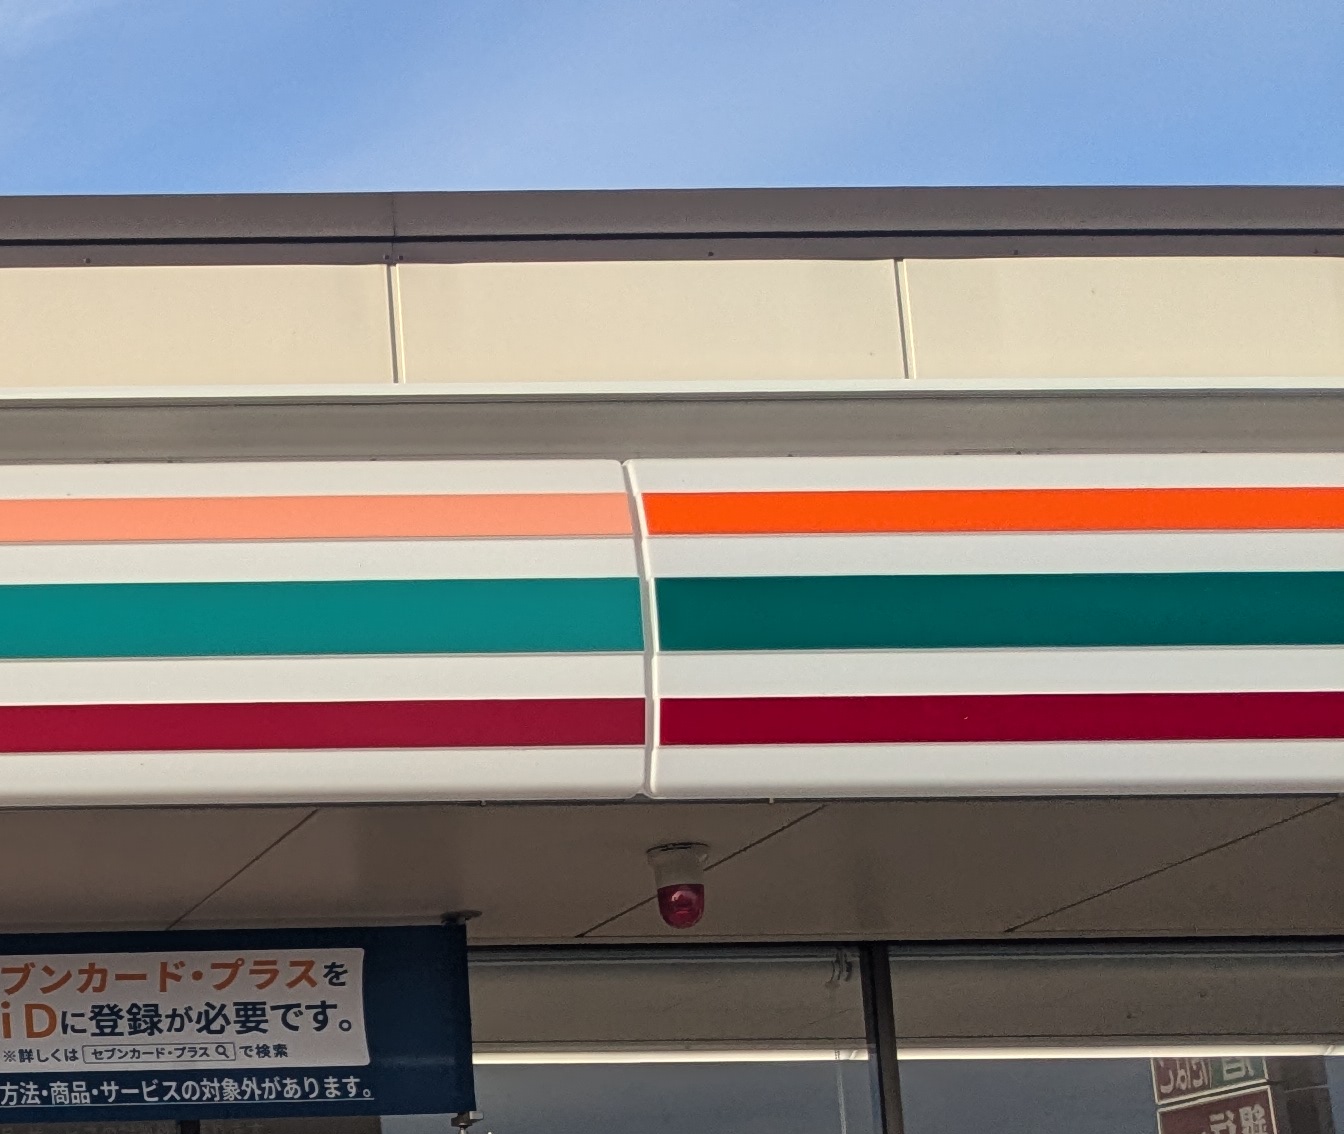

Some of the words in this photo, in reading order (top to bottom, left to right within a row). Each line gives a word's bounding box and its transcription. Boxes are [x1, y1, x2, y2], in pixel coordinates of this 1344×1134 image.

[3, 1047, 80, 1064] ※詳しくは
[91, 1045, 211, 1062] セブンカード・プラス
[239, 1043, 288, 1060] で検索
